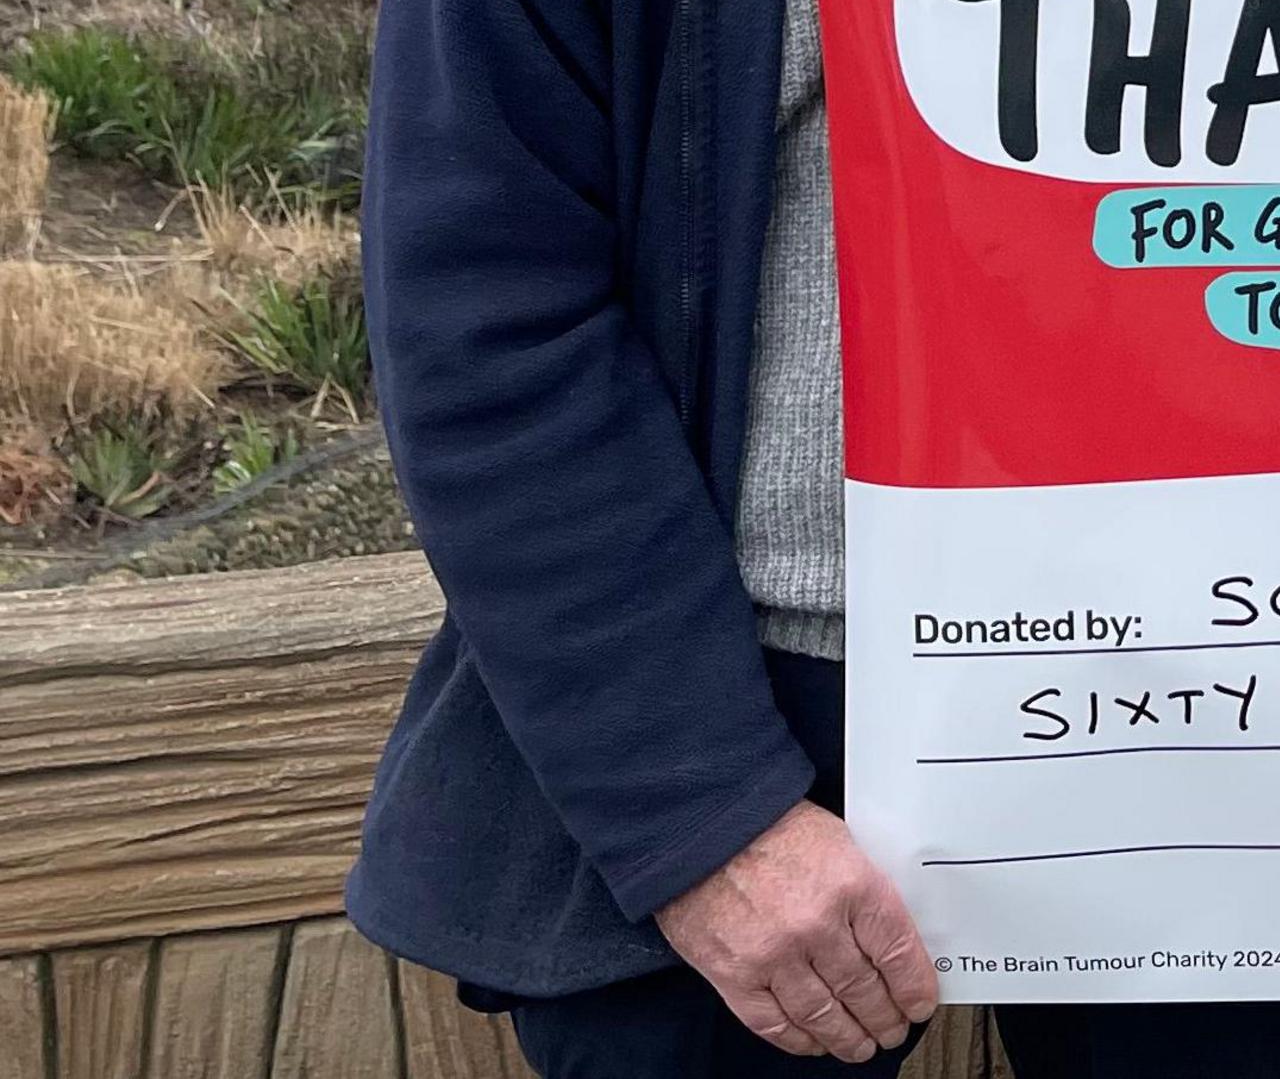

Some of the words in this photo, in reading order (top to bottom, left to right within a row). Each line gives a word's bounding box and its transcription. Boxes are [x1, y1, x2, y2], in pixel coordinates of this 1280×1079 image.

[1130, 198, 1235, 262] FOR
[915, 610, 1075, 644] Donated
[1086, 609, 1143, 647] by:
[1020, 675, 1257, 741] SIXTY
[957, 956, 998, 973] The
[1003, 956, 1059, 973] Brain
[1063, 955, 1146, 972] Tumour
[1151, 950, 1228, 972] Charity
